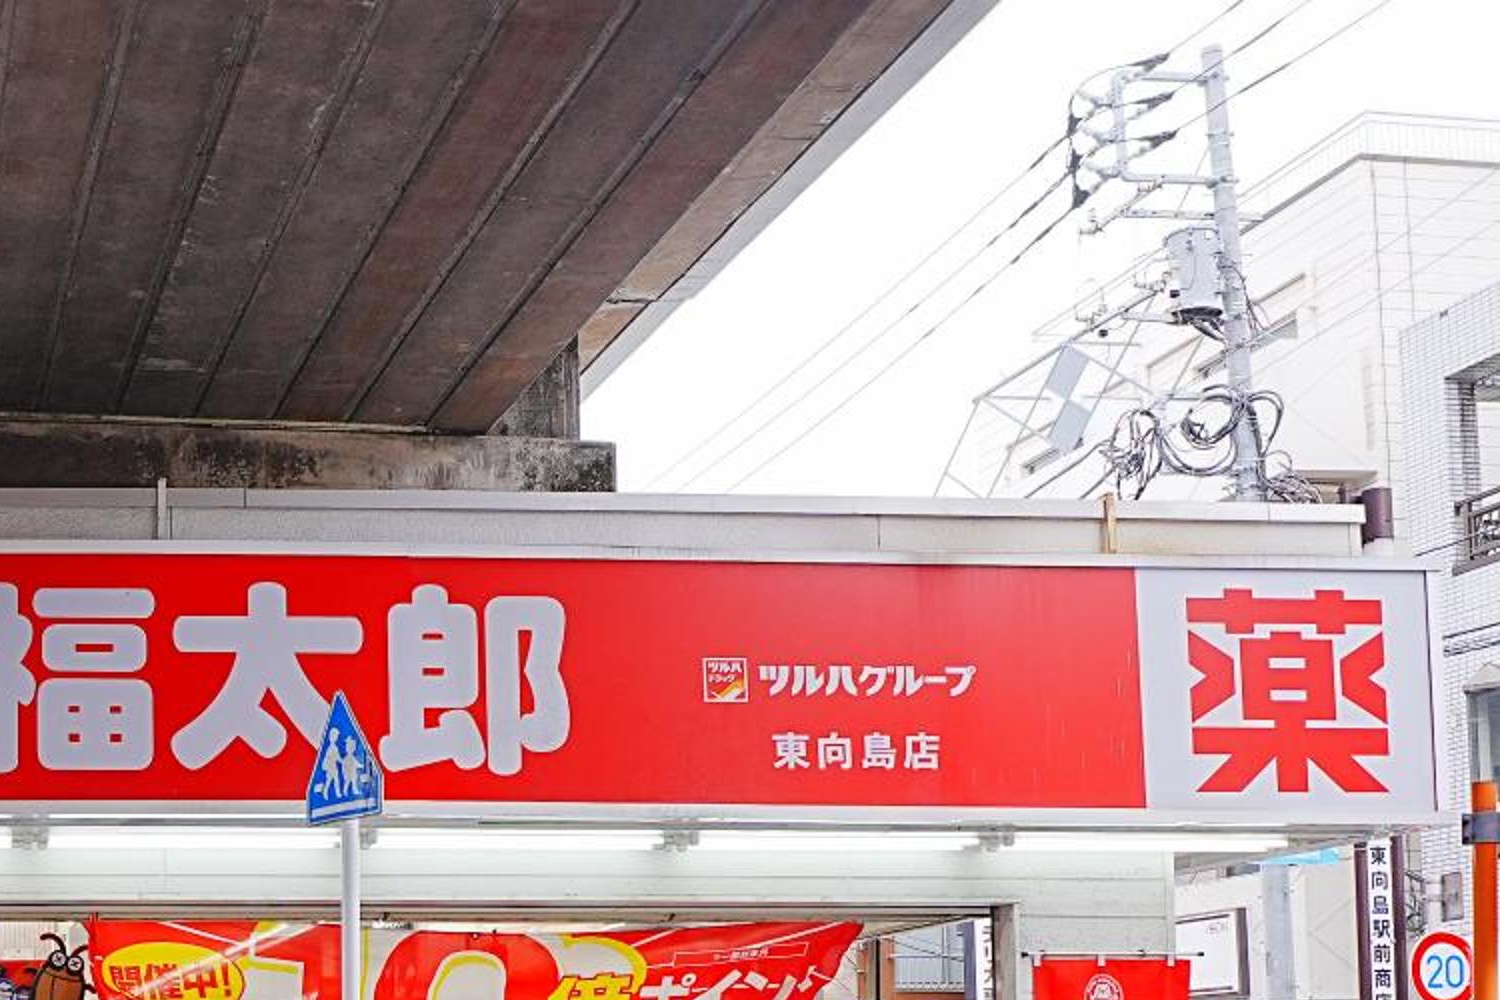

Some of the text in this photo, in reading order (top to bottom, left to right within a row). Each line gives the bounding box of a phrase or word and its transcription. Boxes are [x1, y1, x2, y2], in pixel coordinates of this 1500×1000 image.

[758, 665, 977, 697] ツルハグループ
[1185, 588, 1389, 793] 薬
[771, 731, 941, 770] 東向島店
[1427, 956, 1465, 988] 20
